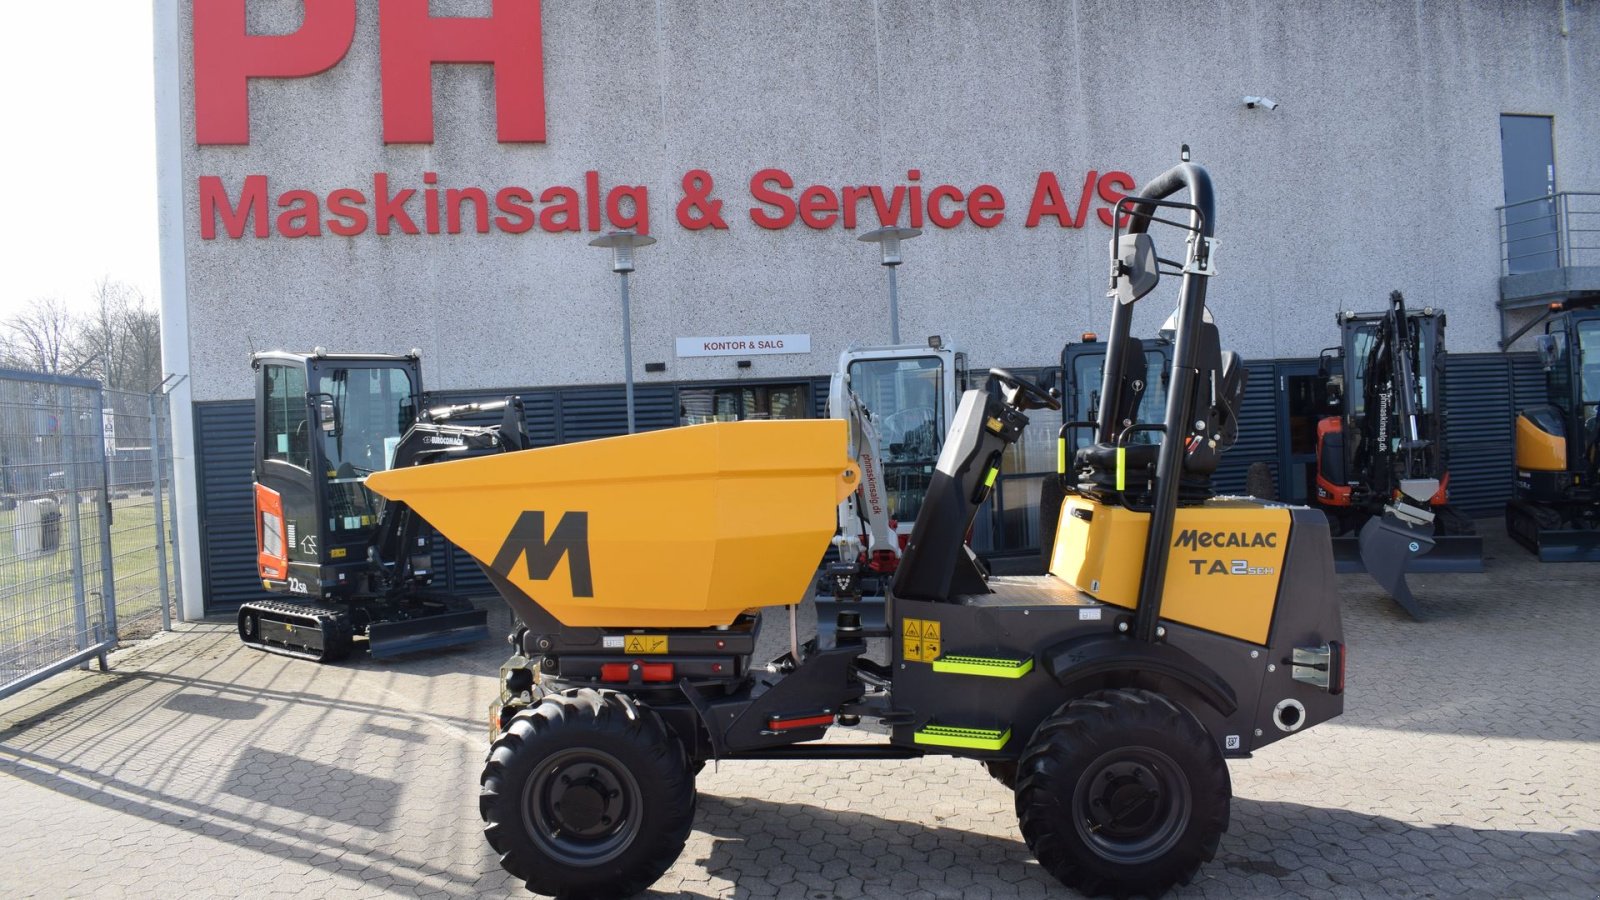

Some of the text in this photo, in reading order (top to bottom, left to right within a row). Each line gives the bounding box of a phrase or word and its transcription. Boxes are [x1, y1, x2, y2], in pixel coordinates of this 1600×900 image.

[193, 0, 546, 144] PH
[200, 168, 1137, 239] Maskinsalg & Service A/S
[703, 340, 784, 351] KONTOR & SALG
[1377, 393, 1389, 452] phmaskinsalg.dk
[861, 453, 882, 515] phmaskinsalg.dk
[490, 510, 594, 598] M
